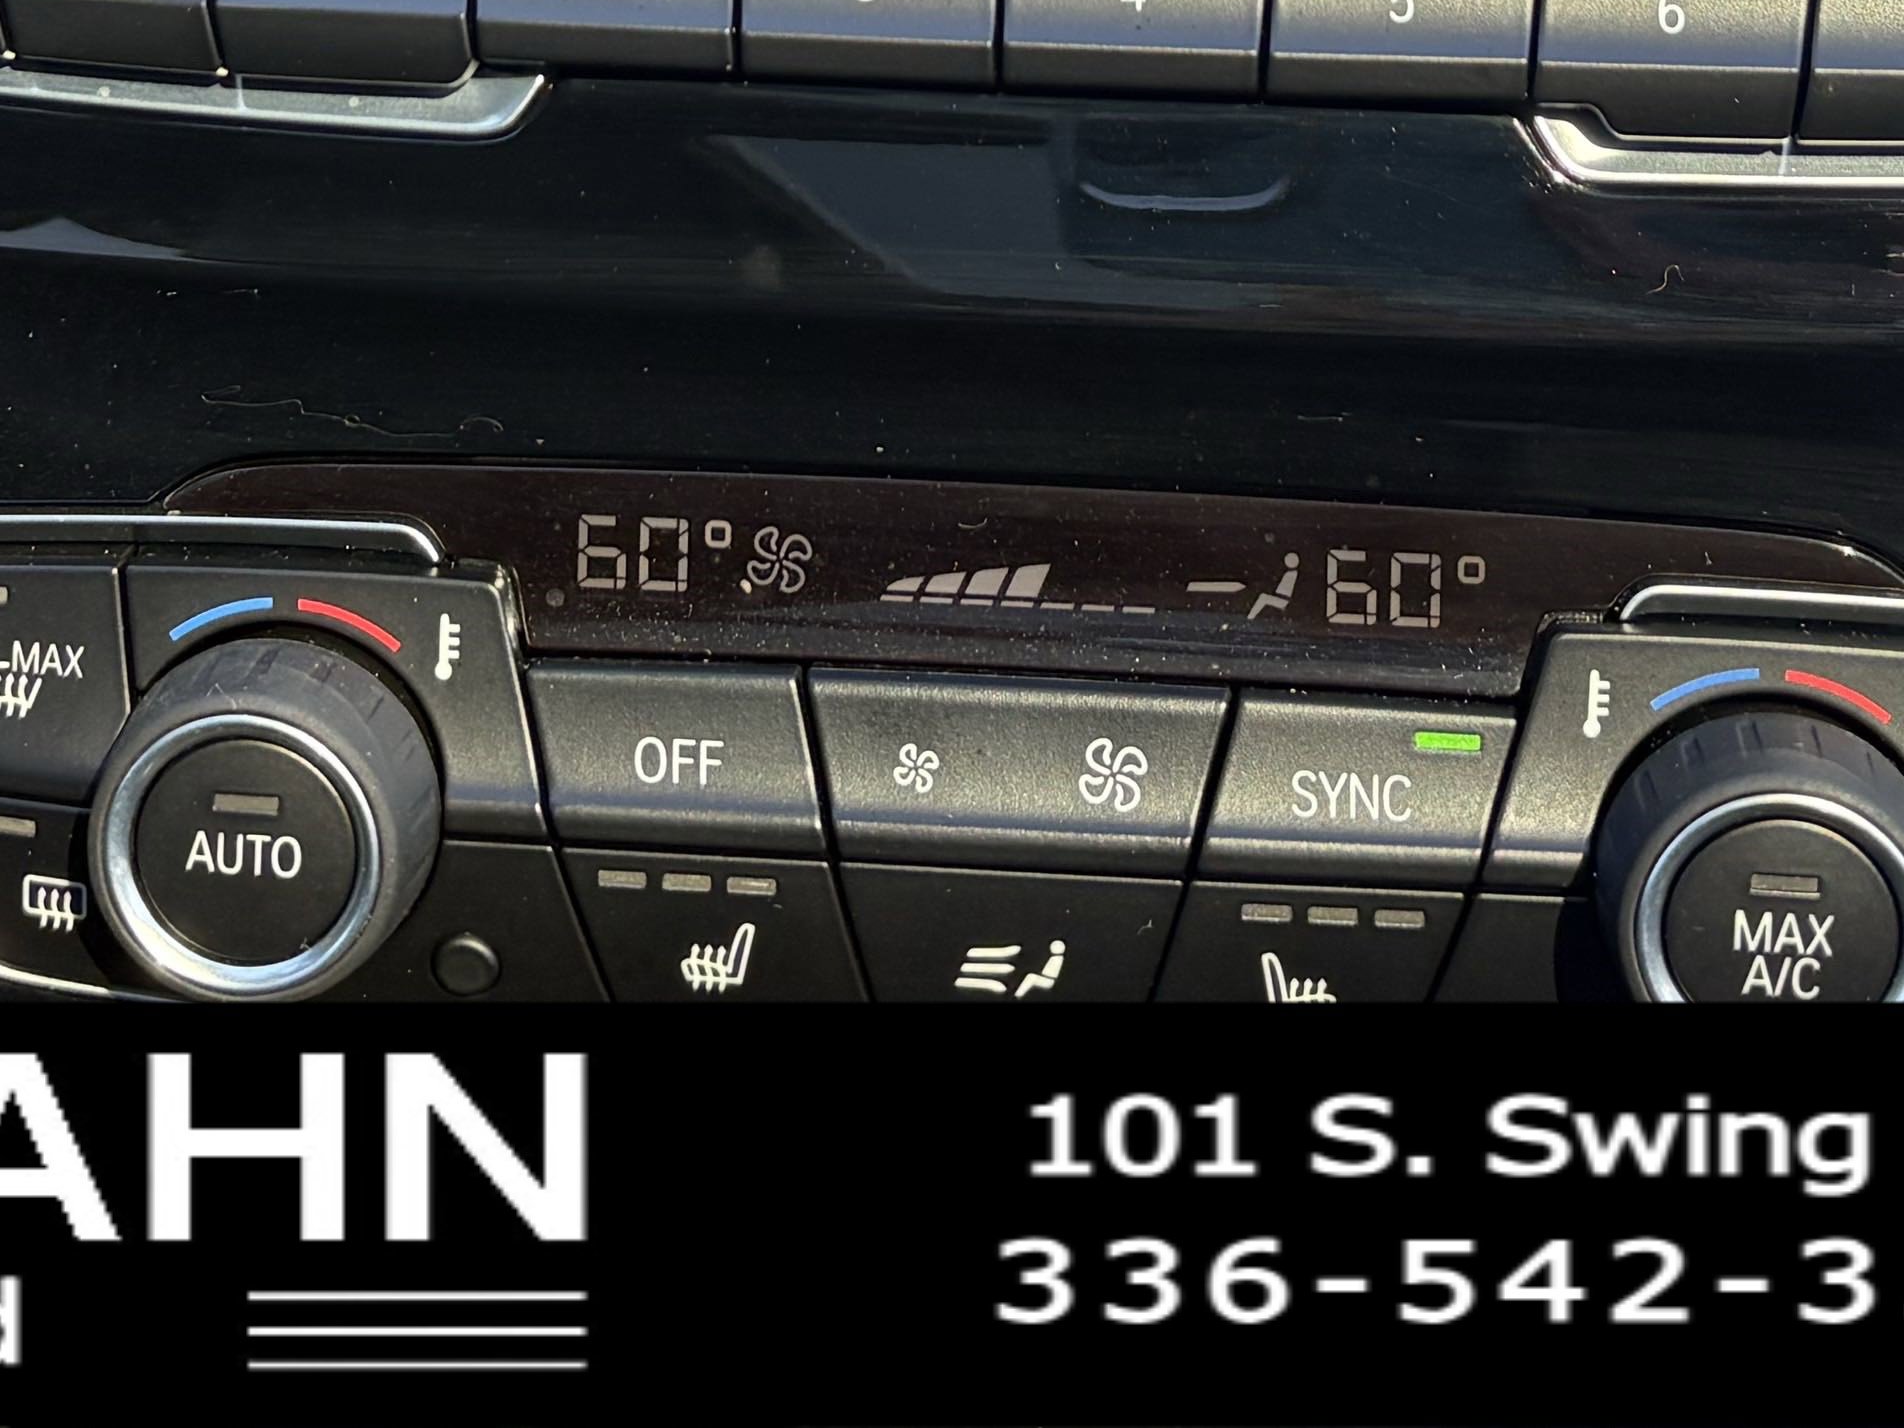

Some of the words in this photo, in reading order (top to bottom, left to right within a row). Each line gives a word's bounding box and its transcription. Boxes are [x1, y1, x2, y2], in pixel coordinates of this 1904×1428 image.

[11, 640, 85, 679] MAX
[634, 736, 725, 788] OFF
[1291, 769, 1414, 823] SYNC
[185, 830, 302, 879] AUTO
[1733, 909, 1835, 957] MAX
[1741, 954, 1821, 1000] A/C
